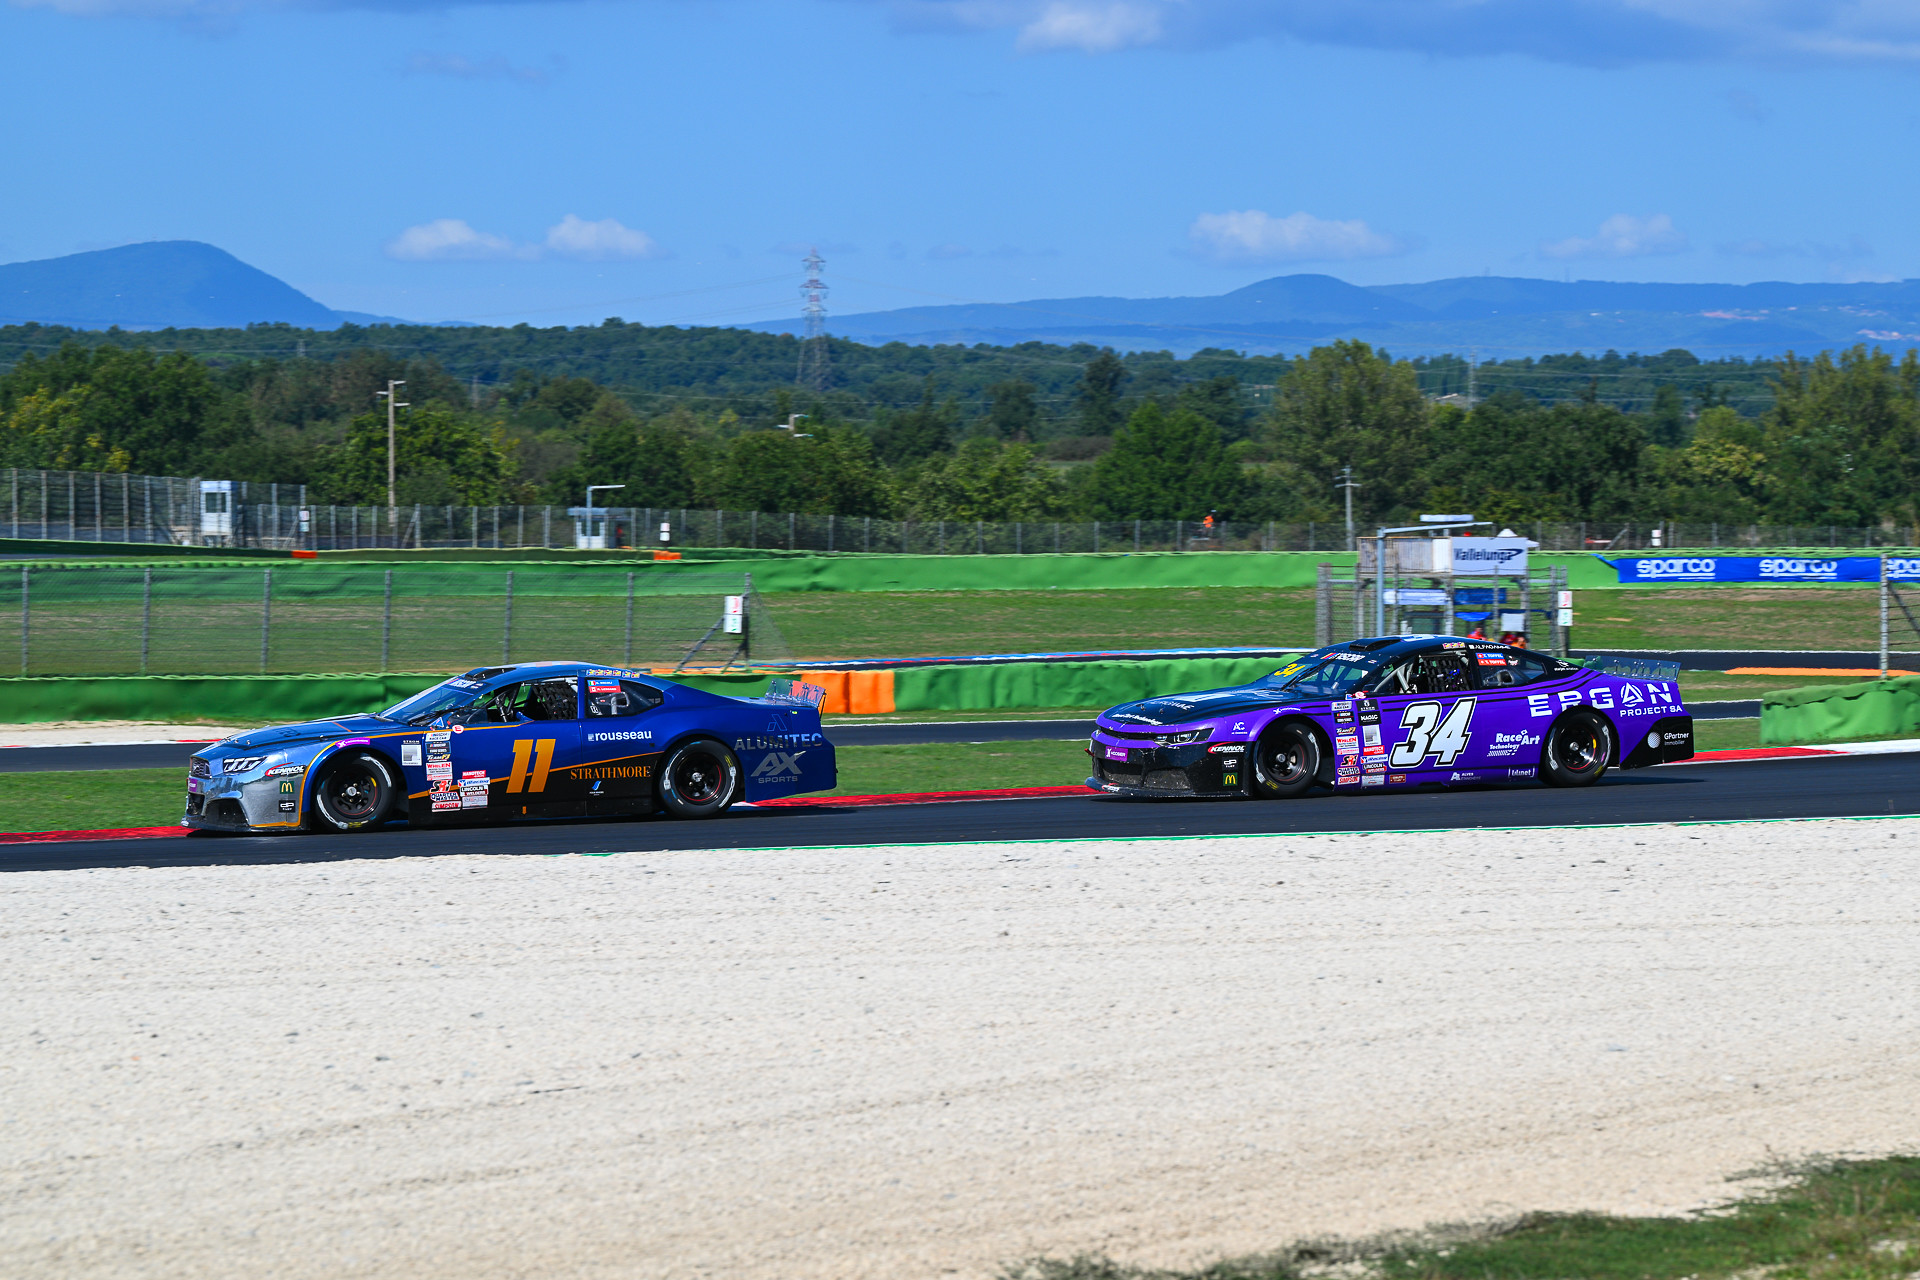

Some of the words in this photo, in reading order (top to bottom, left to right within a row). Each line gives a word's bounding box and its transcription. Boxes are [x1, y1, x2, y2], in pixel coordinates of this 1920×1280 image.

[1453, 548, 1514, 564] Vallelunga
[1636, 558, 1716, 578] sparco
[1759, 558, 1838, 578] sparco
[1273, 663, 1306, 678] 34
[1619, 706, 1668, 718] PROJECT
[1669, 705, 1683, 714] SA
[595, 730, 652, 741] rousseau
[1388, 697, 1478, 769] 34
[1664, 732, 1690, 740] GPartner
[733, 732, 823, 751] ALUMITEC
[1209, 744, 1247, 752] KENNOL
[267, 765, 306, 775] KENNOL
[505, 738, 556, 794] 11
[750, 750, 807, 777] AX
[570, 765, 651, 780] STRATHMORE
[758, 775, 799, 784] SPORTS
